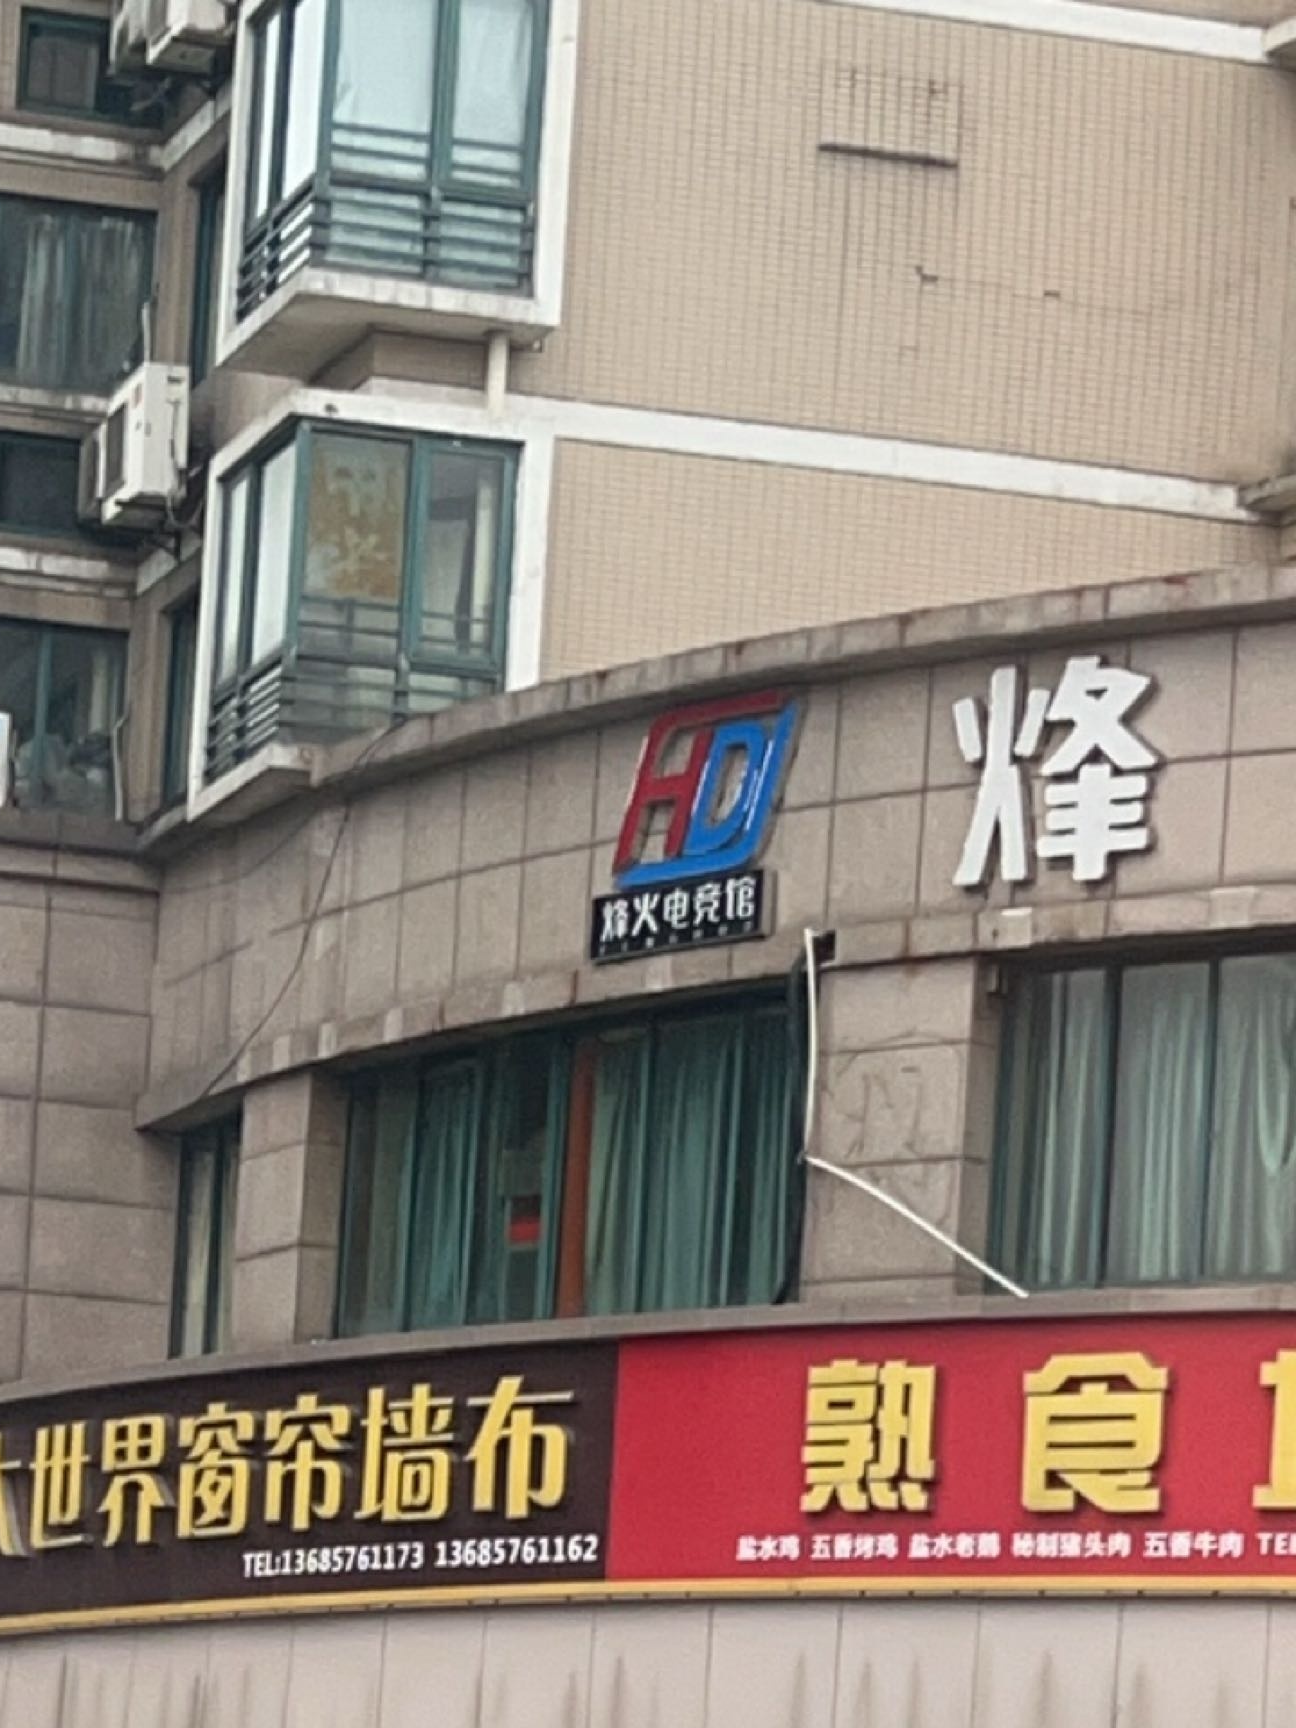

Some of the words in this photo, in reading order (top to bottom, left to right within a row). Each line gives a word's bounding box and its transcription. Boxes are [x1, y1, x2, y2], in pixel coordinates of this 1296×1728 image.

[953, 655, 1158, 886] 烽
[600, 876, 757, 943] 烽火电竞馆
[434, 1534, 598, 1568] 13685761162
